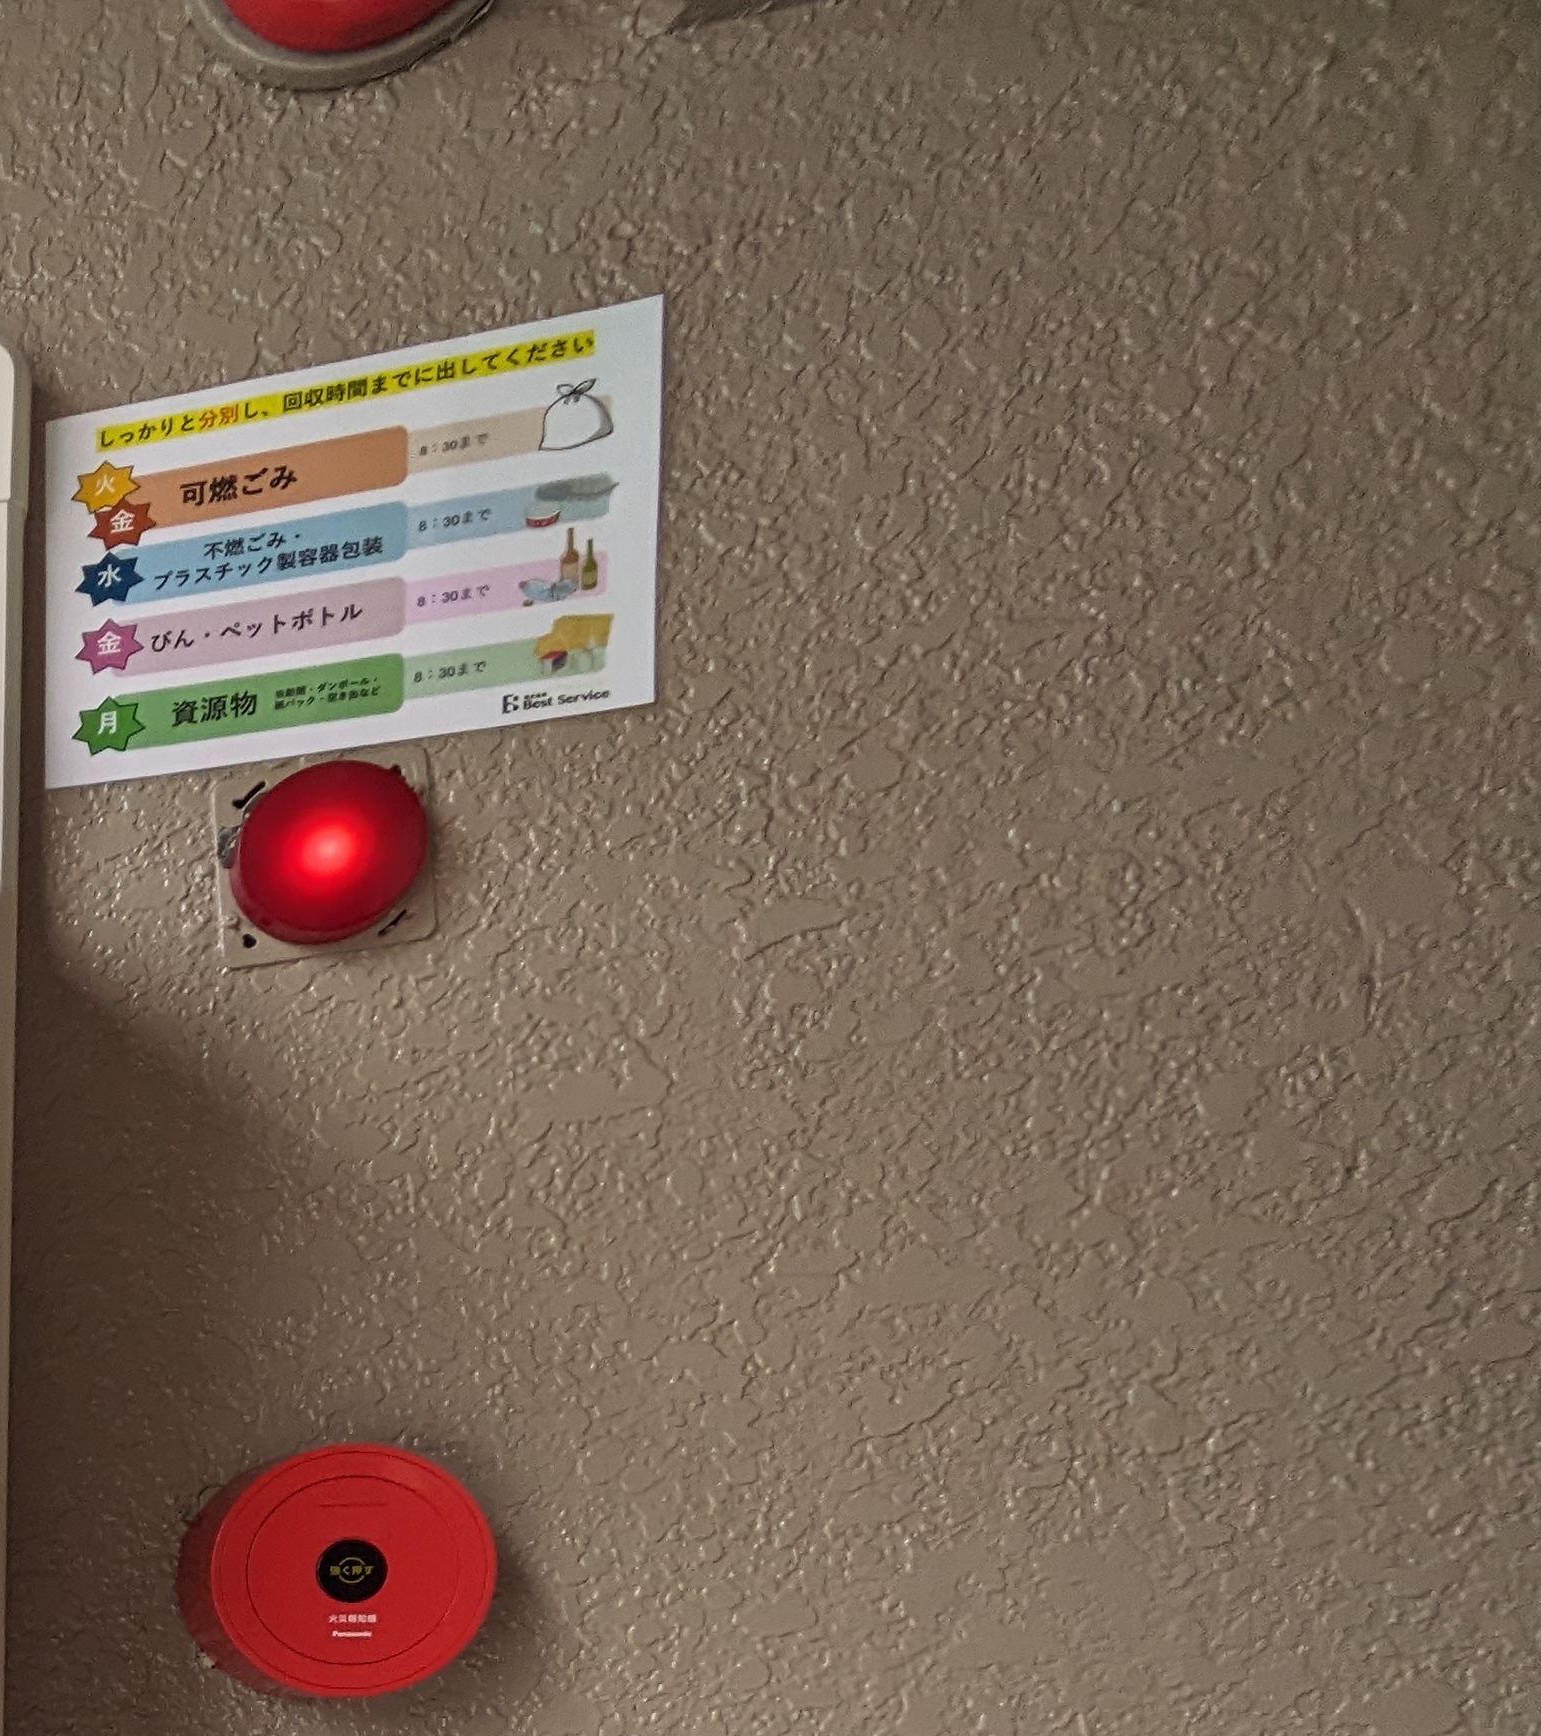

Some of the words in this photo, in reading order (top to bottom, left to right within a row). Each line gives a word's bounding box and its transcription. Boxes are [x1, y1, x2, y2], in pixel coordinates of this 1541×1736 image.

[100, 335, 595, 448] しっかりと分別し、回収時間までに出してください
[95, 477, 115, 494] 火
[179, 464, 298, 508] 可燃ごみ
[109, 509, 135, 534] 金
[153, 535, 384, 591] プラスチック製容器包装
[97, 568, 122, 588] 水
[150, 604, 363, 653] びん・ペットボトル
[97, 631, 123, 656] 金
[172, 691, 257, 728] 資源物
[557, 690, 610, 705] Service
[98, 711, 117, 735] 月
